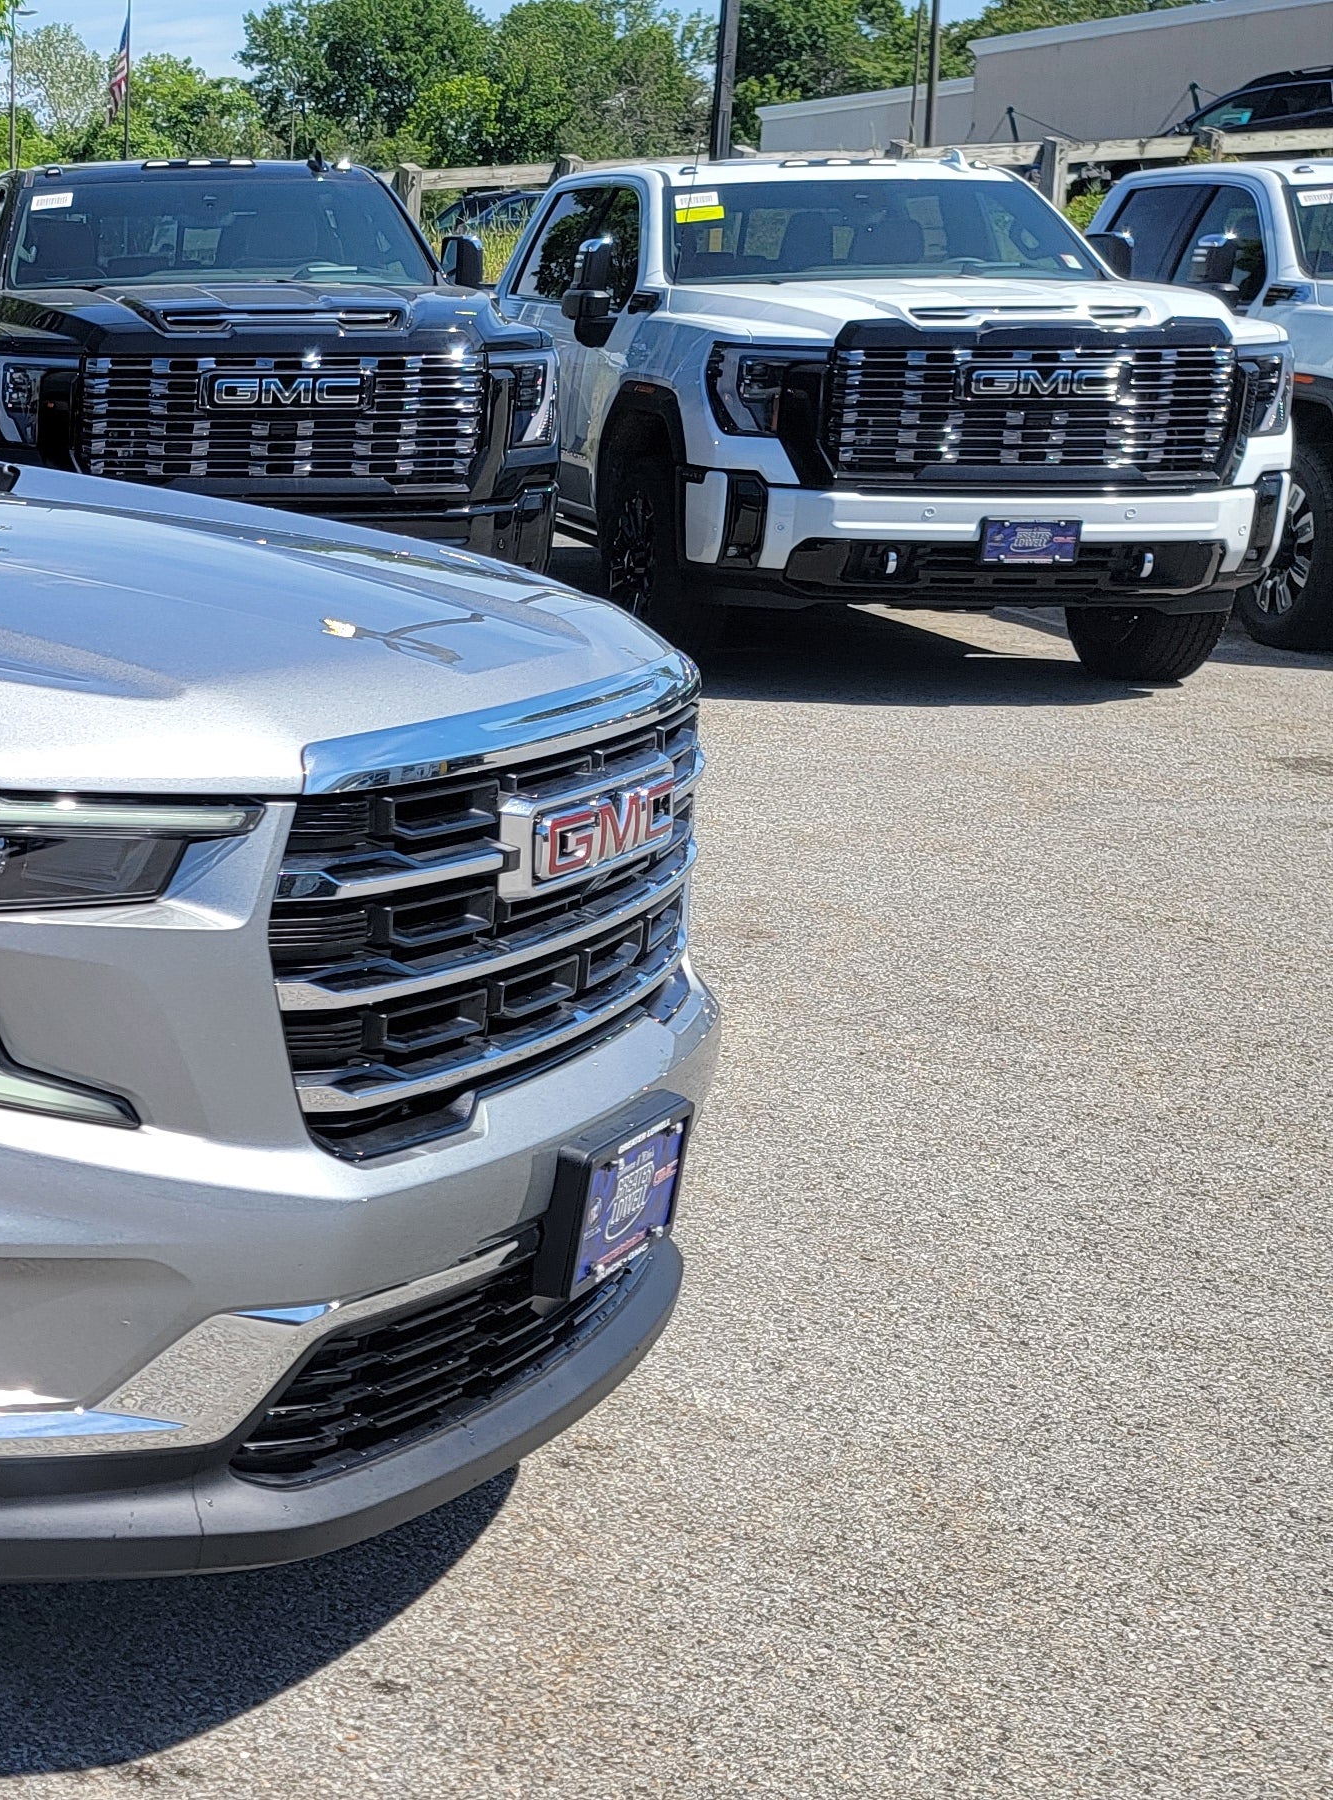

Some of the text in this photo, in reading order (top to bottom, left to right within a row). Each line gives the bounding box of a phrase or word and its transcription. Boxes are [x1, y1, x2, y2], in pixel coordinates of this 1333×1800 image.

[214, 377, 361, 404] GMC
[971, 369, 1117, 395] GMC
[538, 774, 675, 879] GMC
[617, 1163, 654, 1197] GREATER
[610, 1184, 648, 1225] LOWELL
